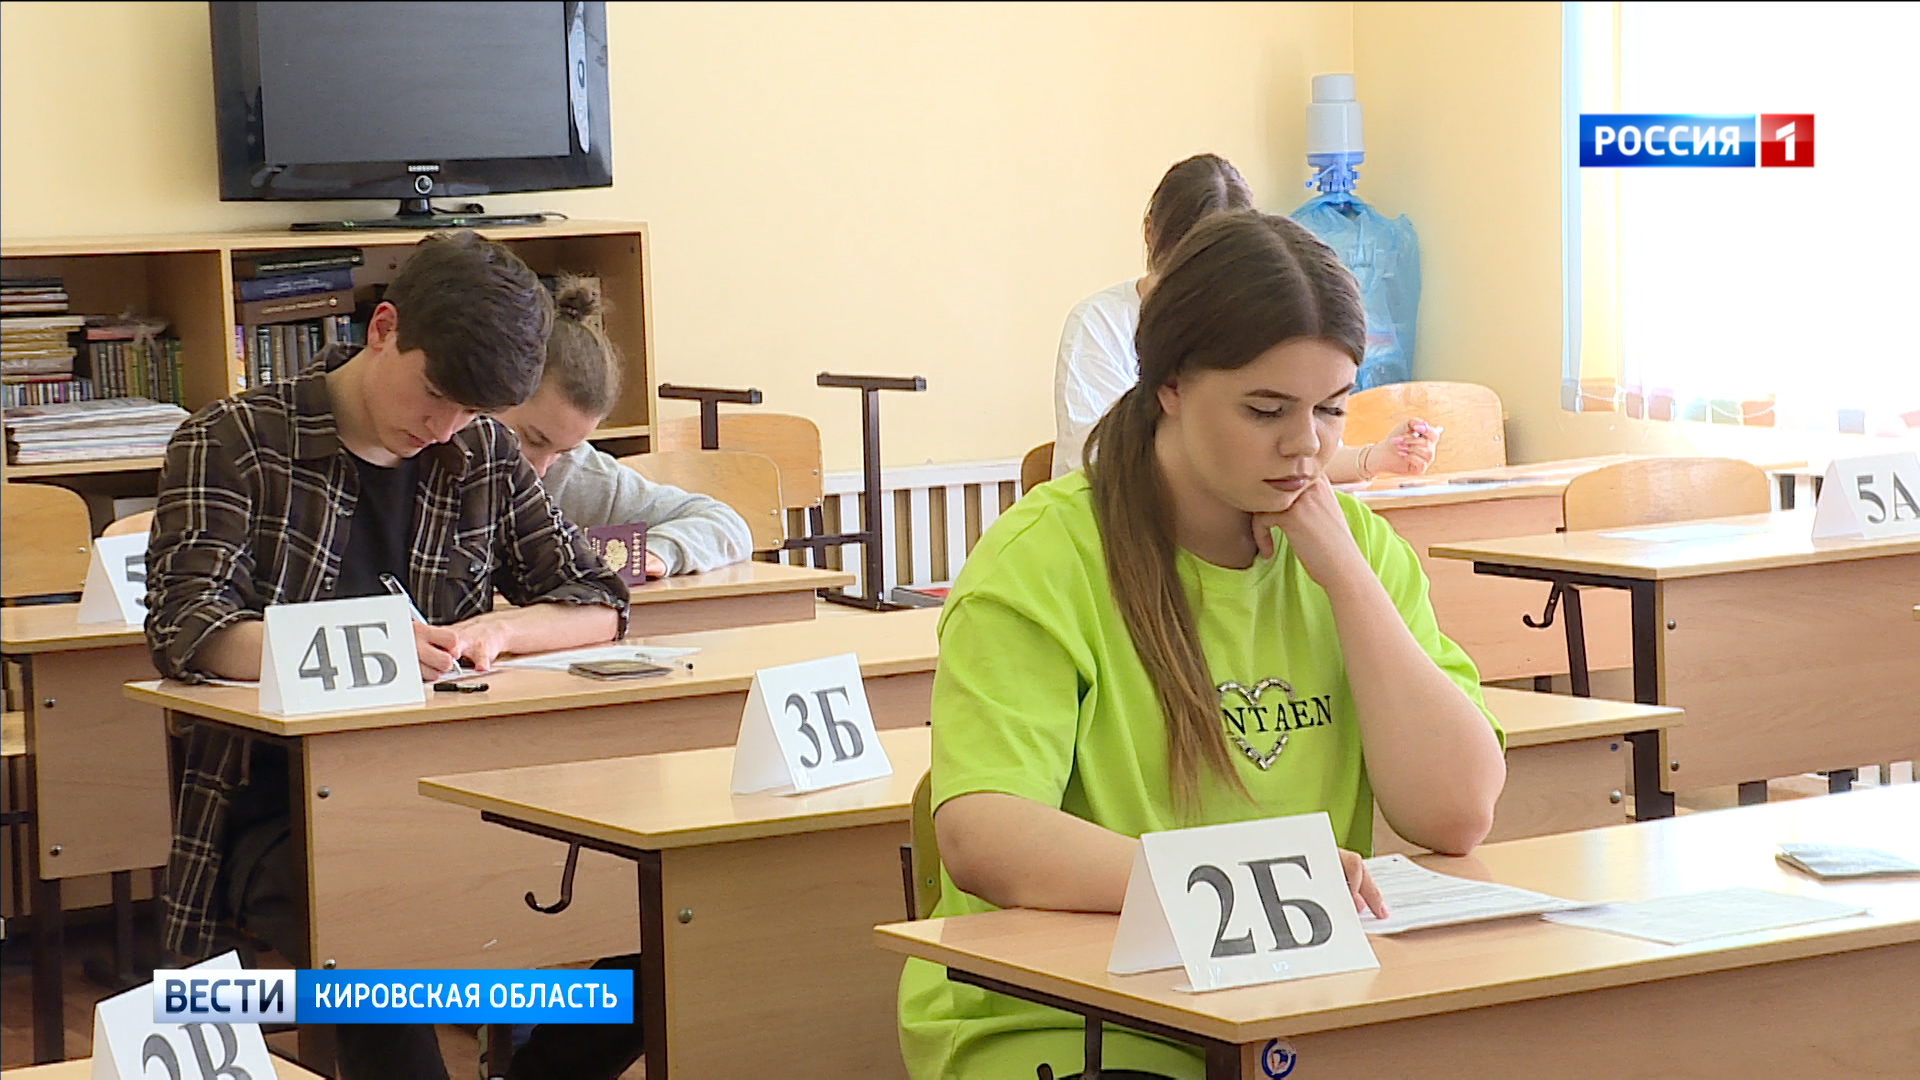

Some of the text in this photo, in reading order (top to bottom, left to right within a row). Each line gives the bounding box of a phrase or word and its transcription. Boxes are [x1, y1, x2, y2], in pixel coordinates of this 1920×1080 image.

[1856, 471, 1920, 524] 5А
[298, 621, 398, 691] 4Б
[784, 685, 865, 769] 3Б
[1186, 854, 1333, 959] 2Б
